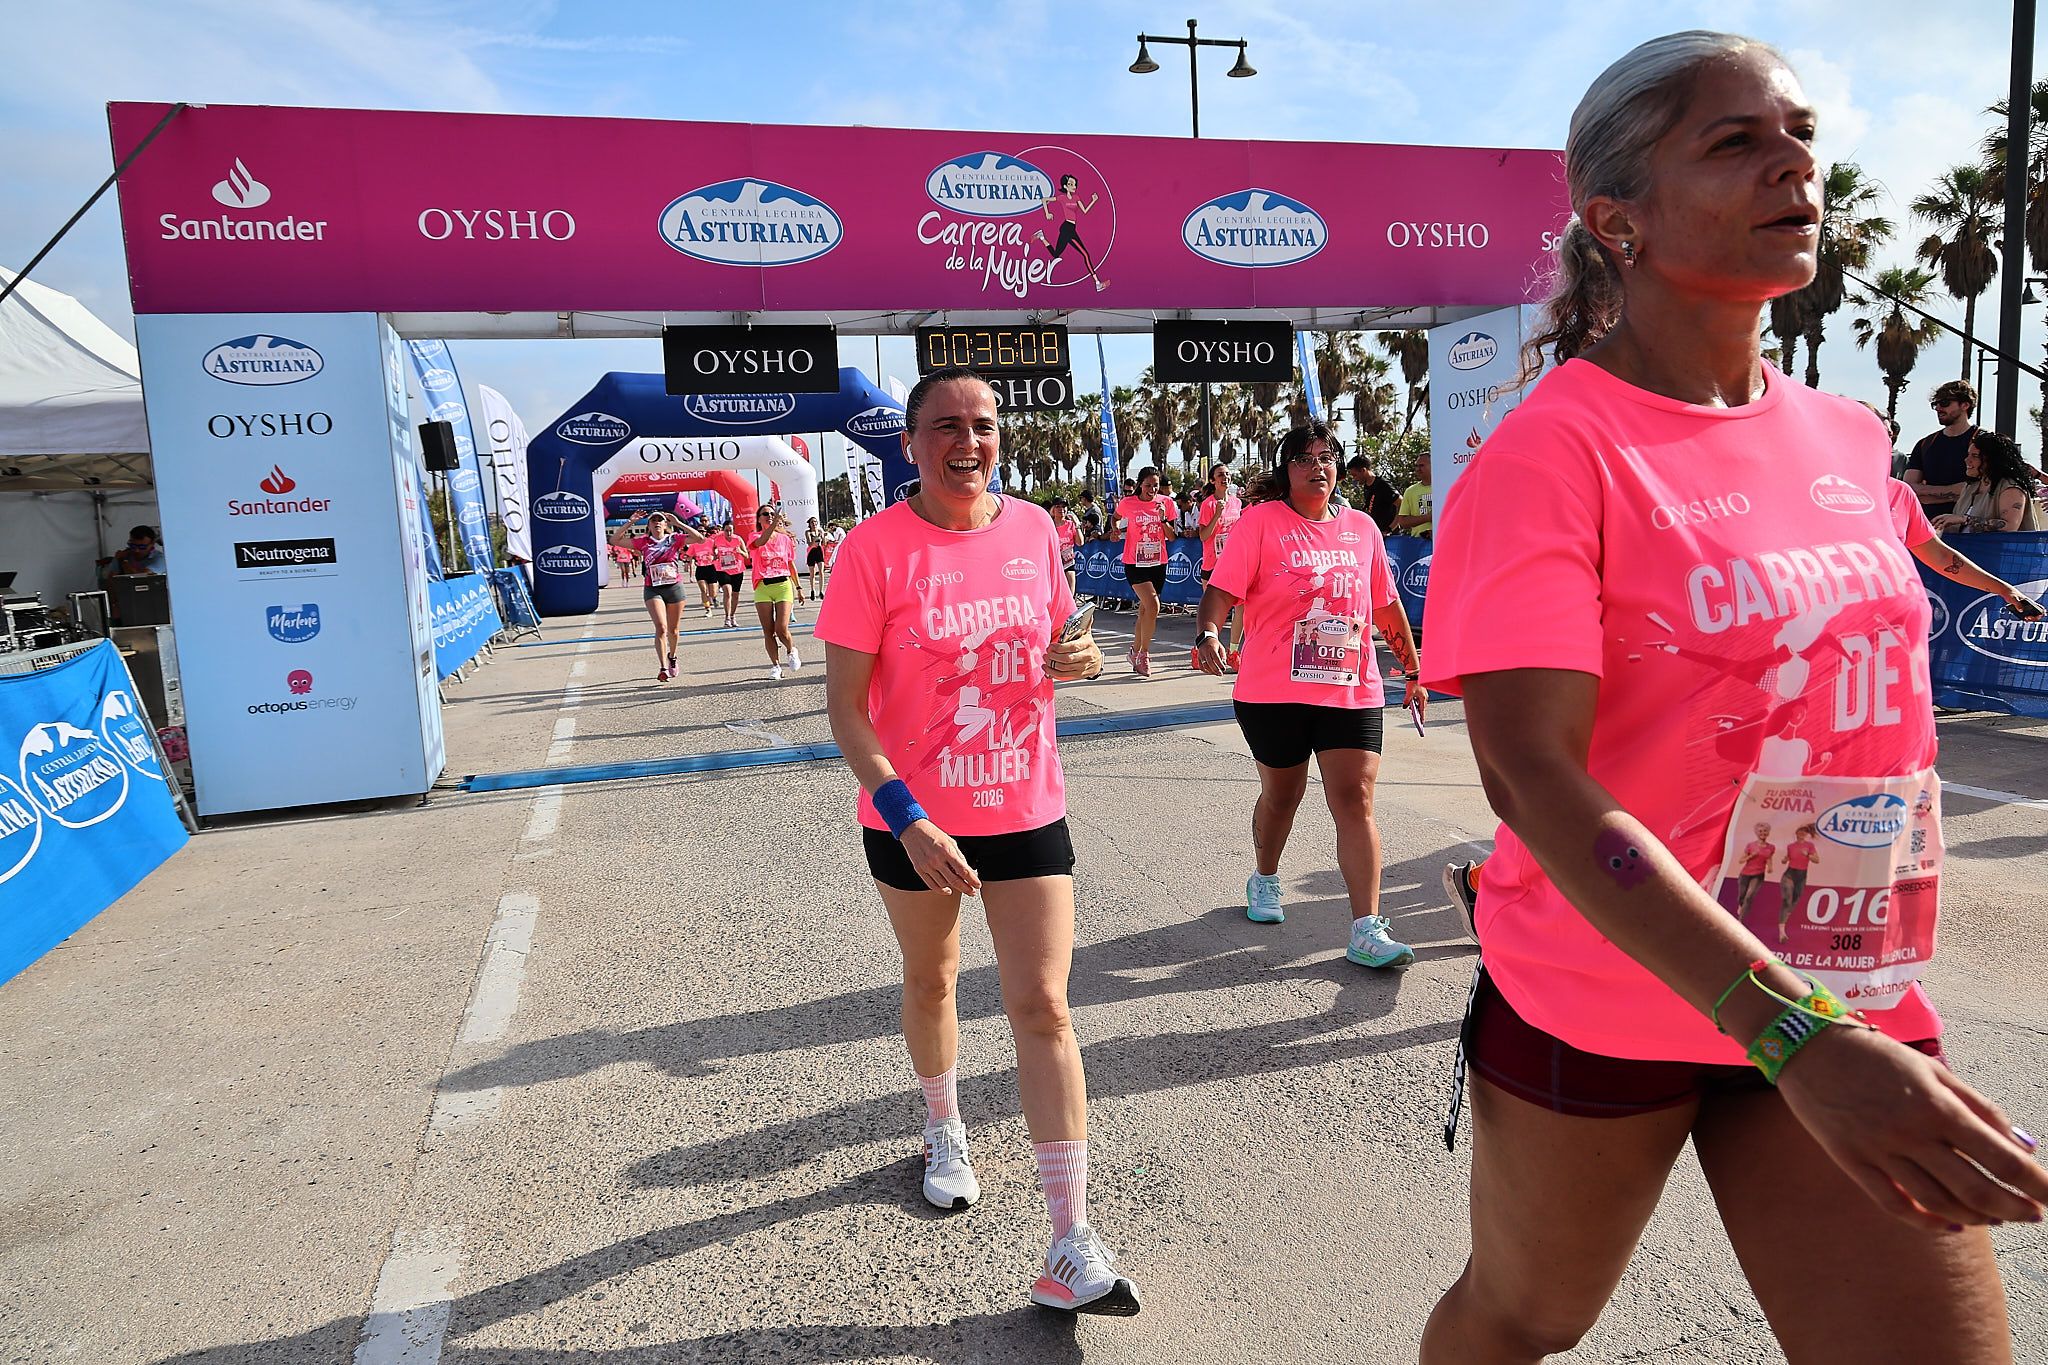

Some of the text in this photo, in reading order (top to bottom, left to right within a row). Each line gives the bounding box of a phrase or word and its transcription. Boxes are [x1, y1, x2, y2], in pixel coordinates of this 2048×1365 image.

[937, 174, 1045, 200] ASTURIANA
[701, 208, 822, 219] CENTRAL LECHERA
[1216, 216, 1312, 225] CENTRAL LECHERA
[160, 213, 327, 241] Santander
[417, 208, 576, 241] OYSHO
[674, 209, 831, 243] ASTURIANA
[917, 211, 1024, 246] Carrera
[1194, 218, 1317, 248] ASTURIANA
[1386, 221, 1489, 249] OYSHO
[945, 244, 1062, 298] de la Mujer
[928, 331, 1060, 367] 00:36:08
[1177, 340, 1275, 364] OYSHO
[1452, 347, 1494, 364] ASTURIANA
[213, 354, 316, 373] ASTURIANA
[693, 349, 814, 376] OYSHO
[693, 395, 787, 413] ASTURIANA
[1448, 385, 1499, 410] OYSHO
[208, 412, 333, 438] OYSHO
[562, 424, 625, 437] ASTURIANA
[640, 440, 740, 463] OYSHO
[769, 459, 798, 467] OYSHO
[620, 471, 707, 484] Sports Santander
[228, 497, 331, 516] Santander
[536, 503, 587, 515] ASTURIANA
[787, 499, 814, 507] OYSHO
[1651, 492, 1751, 531] OYSHO
[241, 547, 329, 563] Neutrogena
[540, 556, 590, 568] ASTURIANA
[1291, 550, 1359, 568] CARRERA
[915, 571, 964, 590] OYSHO
[1331, 571, 1352, 599] DE
[1686, 537, 1919, 634] CARRERA
[271, 613, 318, 634] Marlene
[927, 594, 1038, 641] CARRERA
[990, 640, 1026, 686] DE
[1318, 646, 1346, 660] 016
[1300, 672, 1325, 680] OYSHO
[1831, 625, 1905, 732] DE
[248, 697, 358, 715] octopus energy
[938, 749, 1030, 789] MUJER
[972, 788, 1004, 808] 2026
[1761, 797, 1815, 813] SUMA
[1806, 887, 1889, 925] 016
[1830, 934, 1862, 951] 308
[1796, 953, 1813, 965] DE
[1816, 954, 1831, 967] LA
[1835, 955, 1875, 969] MUJER
